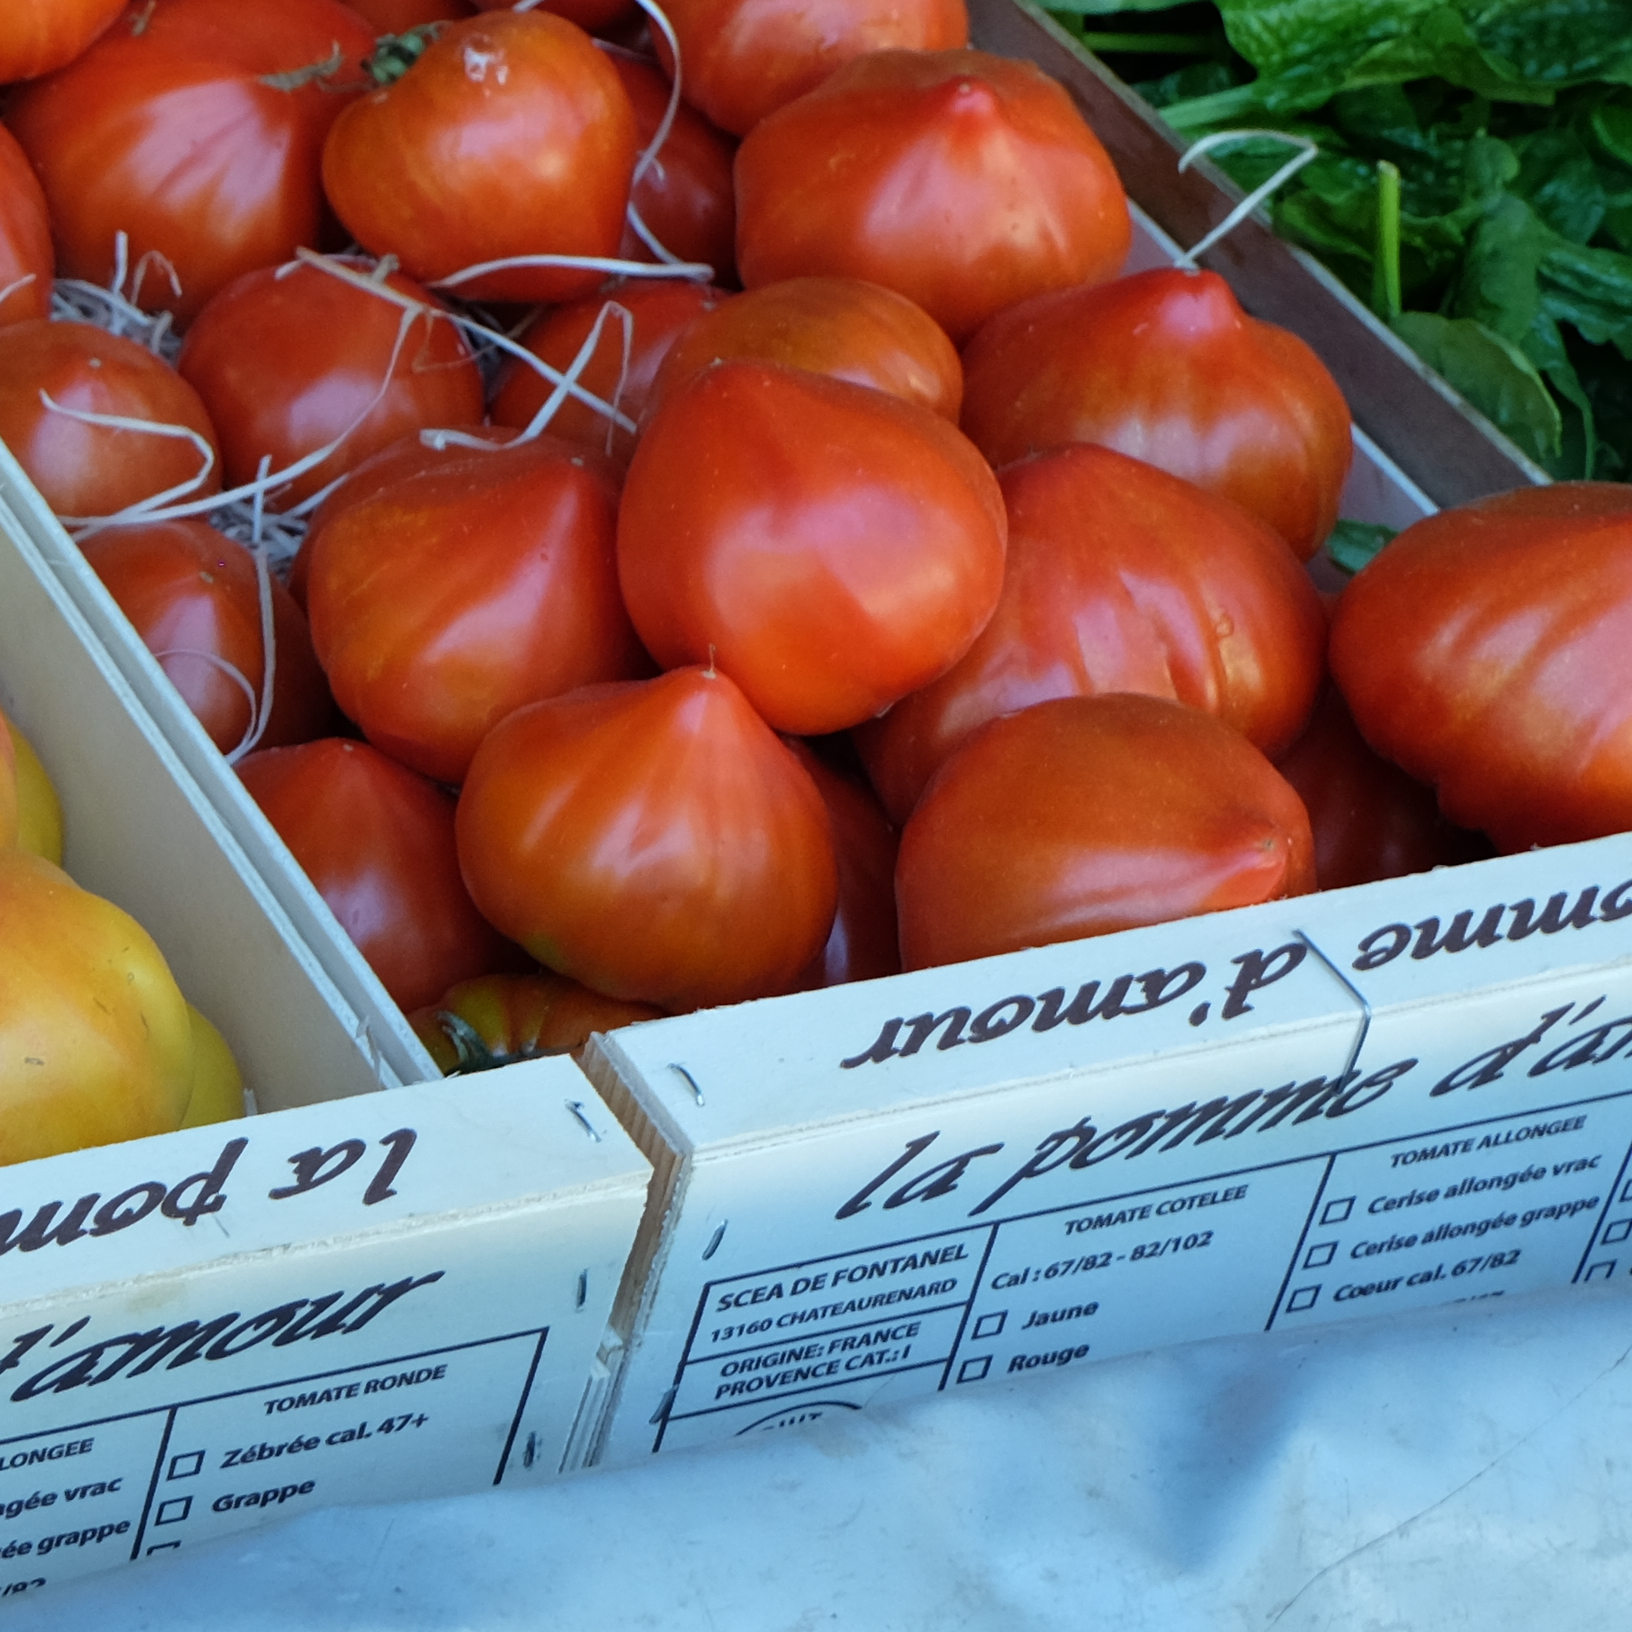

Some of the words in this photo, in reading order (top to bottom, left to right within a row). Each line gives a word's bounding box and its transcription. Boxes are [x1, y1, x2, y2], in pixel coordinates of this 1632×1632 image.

[840, 941, 1308, 1070] d'amour
[835, 1131, 1004, 1220] la
[968, 1057, 1418, 1216] pomme
[1391, 1138, 1475, 1168] TOMATE
[1477, 1115, 1587, 1150] ALLONGEE
[269, 1128, 418, 1206] la
[1367, 1188, 1440, 1215] Cerise
[1443, 1164, 1547, 1200] allongée
[1552, 1155, 1602, 1177] vrac
[1064, 1203, 1152, 1235] TOMATE
[1155, 1184, 1249, 1216] COTELEE
[1350, 1233, 1416, 1259] Cerise
[1421, 1212, 1517, 1246] allongée
[1520, 1195, 1600, 1229] grappe
[716, 1282, 784, 1313] SCEA
[789, 1277, 827, 1297] DE
[830, 1243, 969, 1287] FONTANEL
[1044, 1252, 1113, 1279] 67/82
[1129, 1230, 1214, 1262] 82/102
[1333, 1276, 1404, 1302] Coeur
[1406, 1263, 1446, 1287] cal.
[1451, 1249, 1522, 1278] 67/82
[710, 1319, 771, 1344] 13160
[775, 1278, 958, 1329] CHATEAURENARD
[1021, 1301, 1099, 1330] Jaune
[720, 1345, 825, 1378] ORIGINE:
[827, 1321, 922, 1355] FRANCE
[1007, 1344, 1090, 1374] Rouge
[264, 1381, 360, 1415] TOMATE
[364, 1364, 448, 1395] RONDE
[714, 1361, 841, 1400] PROVENCE
[219, 1434, 321, 1469] Zébrée
[325, 1421, 372, 1447] cal.
[377, 1412, 429, 1434] 47+
[64, 1478, 123, 1502] vrac
[212, 1480, 316, 1513] Grappe
[37, 1520, 131, 1556] grappe
